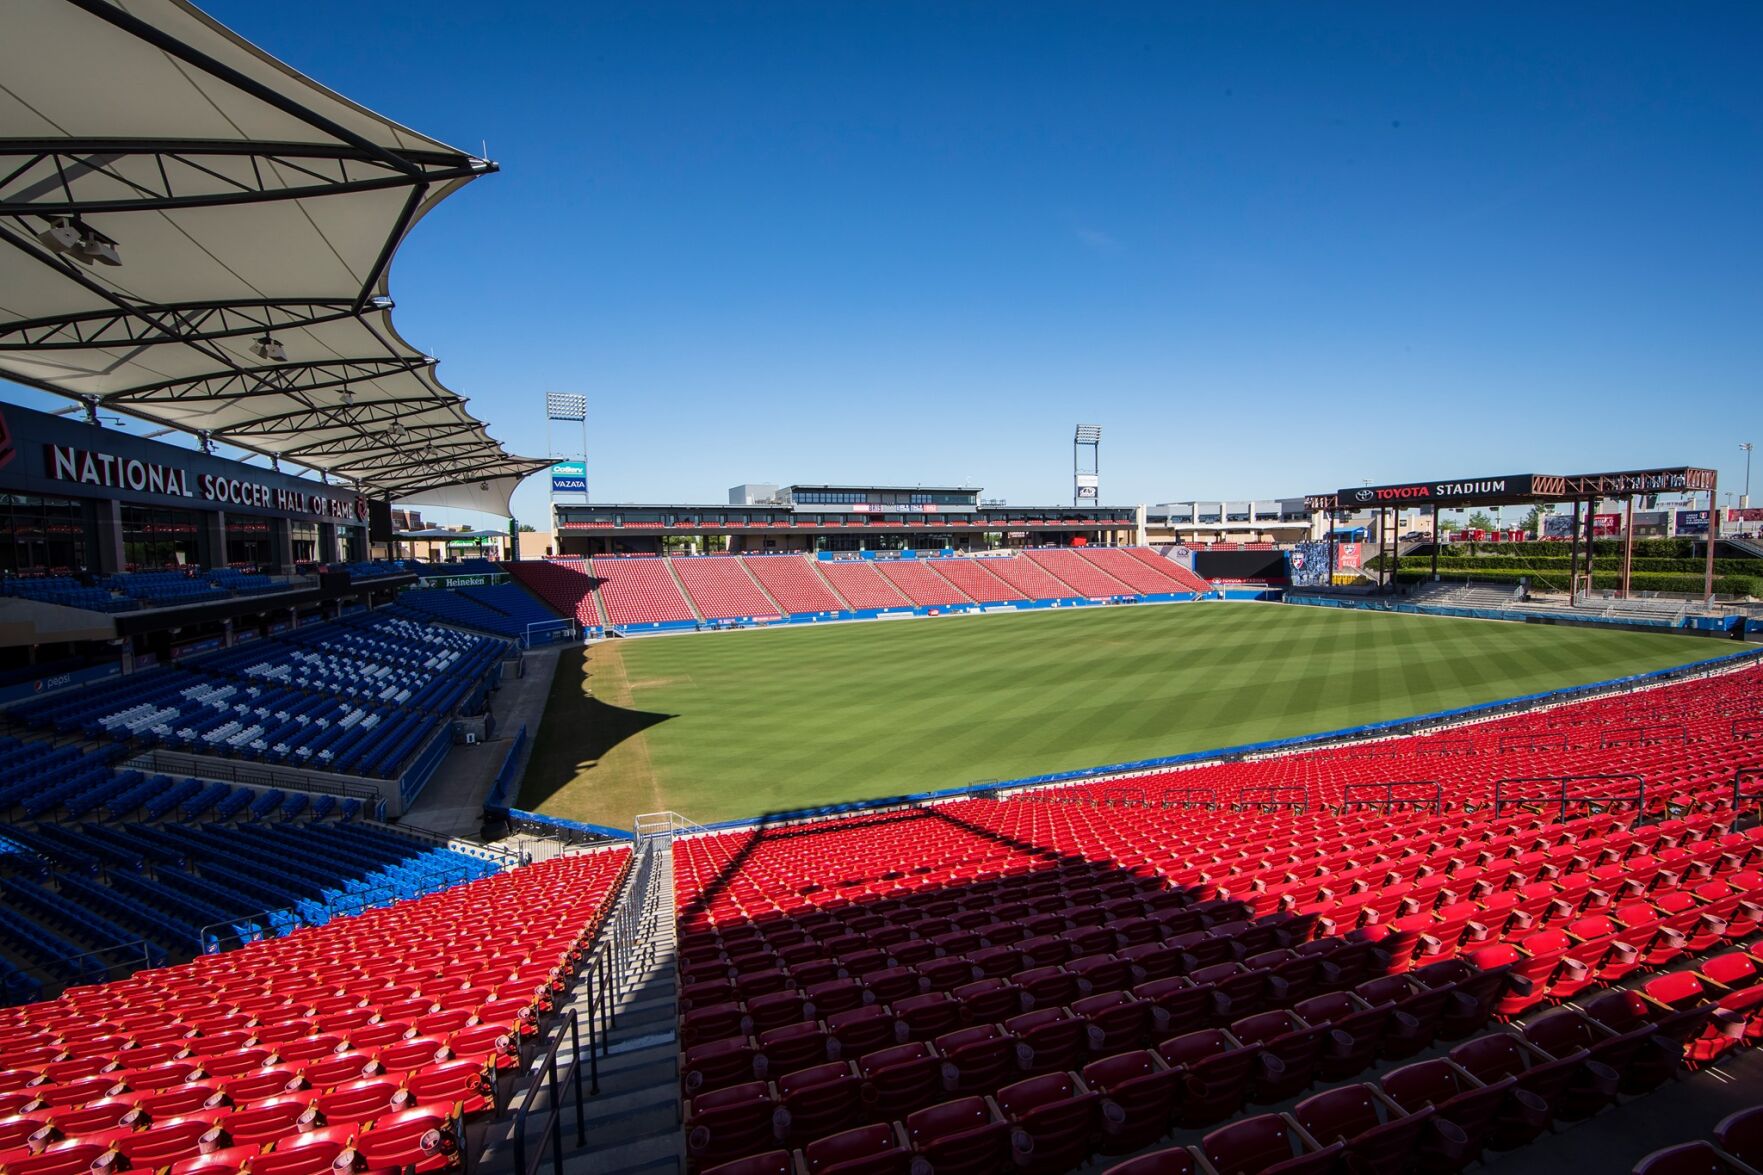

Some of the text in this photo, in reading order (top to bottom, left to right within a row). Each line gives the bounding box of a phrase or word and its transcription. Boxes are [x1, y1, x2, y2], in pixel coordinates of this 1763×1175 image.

[53, 444, 353, 519] NATIONAL SOCCER HALL OF FAME
[553, 480, 586, 488] VAZATA
[1376, 480, 1505, 500] TOYOTA STADIUM
[446, 577, 485, 587] Heineken
[47, 673, 70, 688] pepsi
